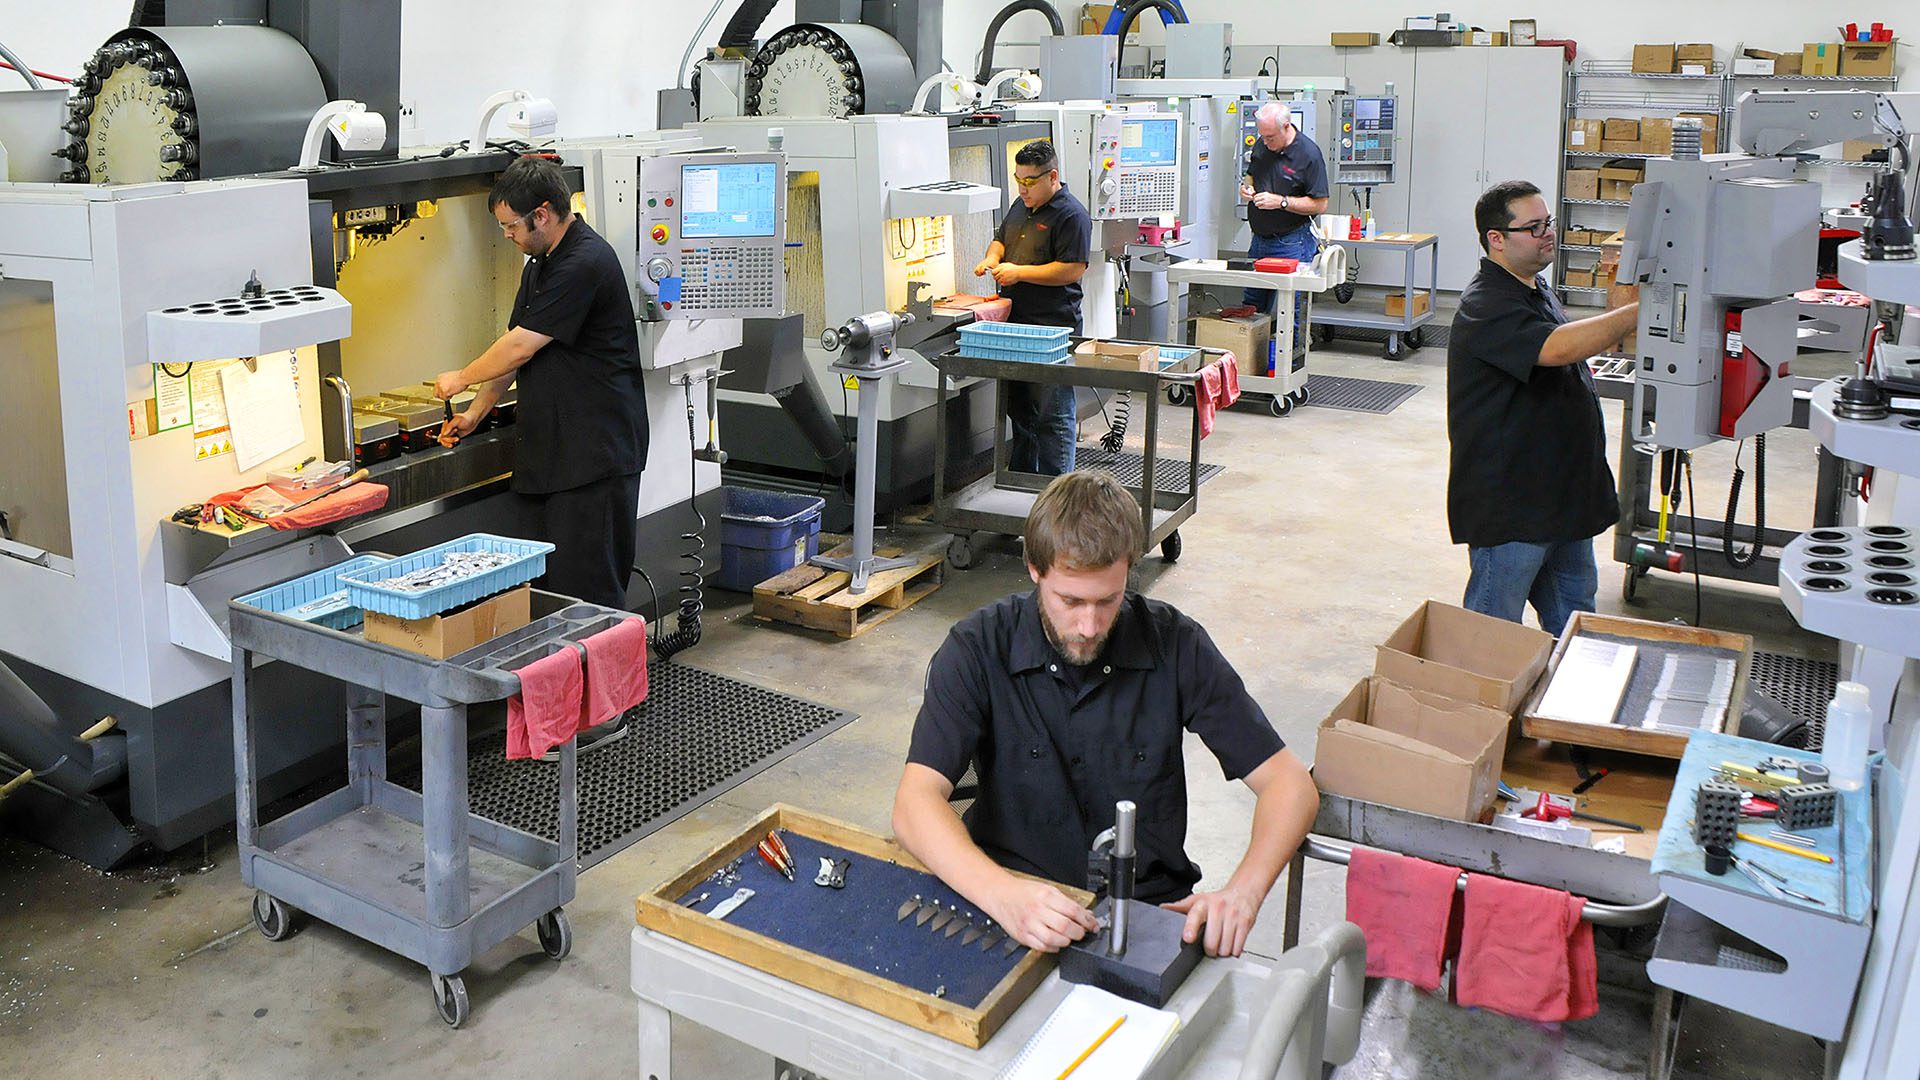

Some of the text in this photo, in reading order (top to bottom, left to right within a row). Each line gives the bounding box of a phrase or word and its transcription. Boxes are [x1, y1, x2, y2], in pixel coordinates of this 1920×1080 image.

[816, 62, 823, 72] 2
[122, 86, 127, 101] 9
[131, 82, 135, 99] 8
[113, 93, 120, 108] 10
[146, 91, 152, 106] 6
[830, 96, 838, 105] 22
[100, 116, 110, 129] 12
[98, 131, 106, 142] 13
[97, 147, 105, 157] 14
[98, 161, 108, 172] 15
